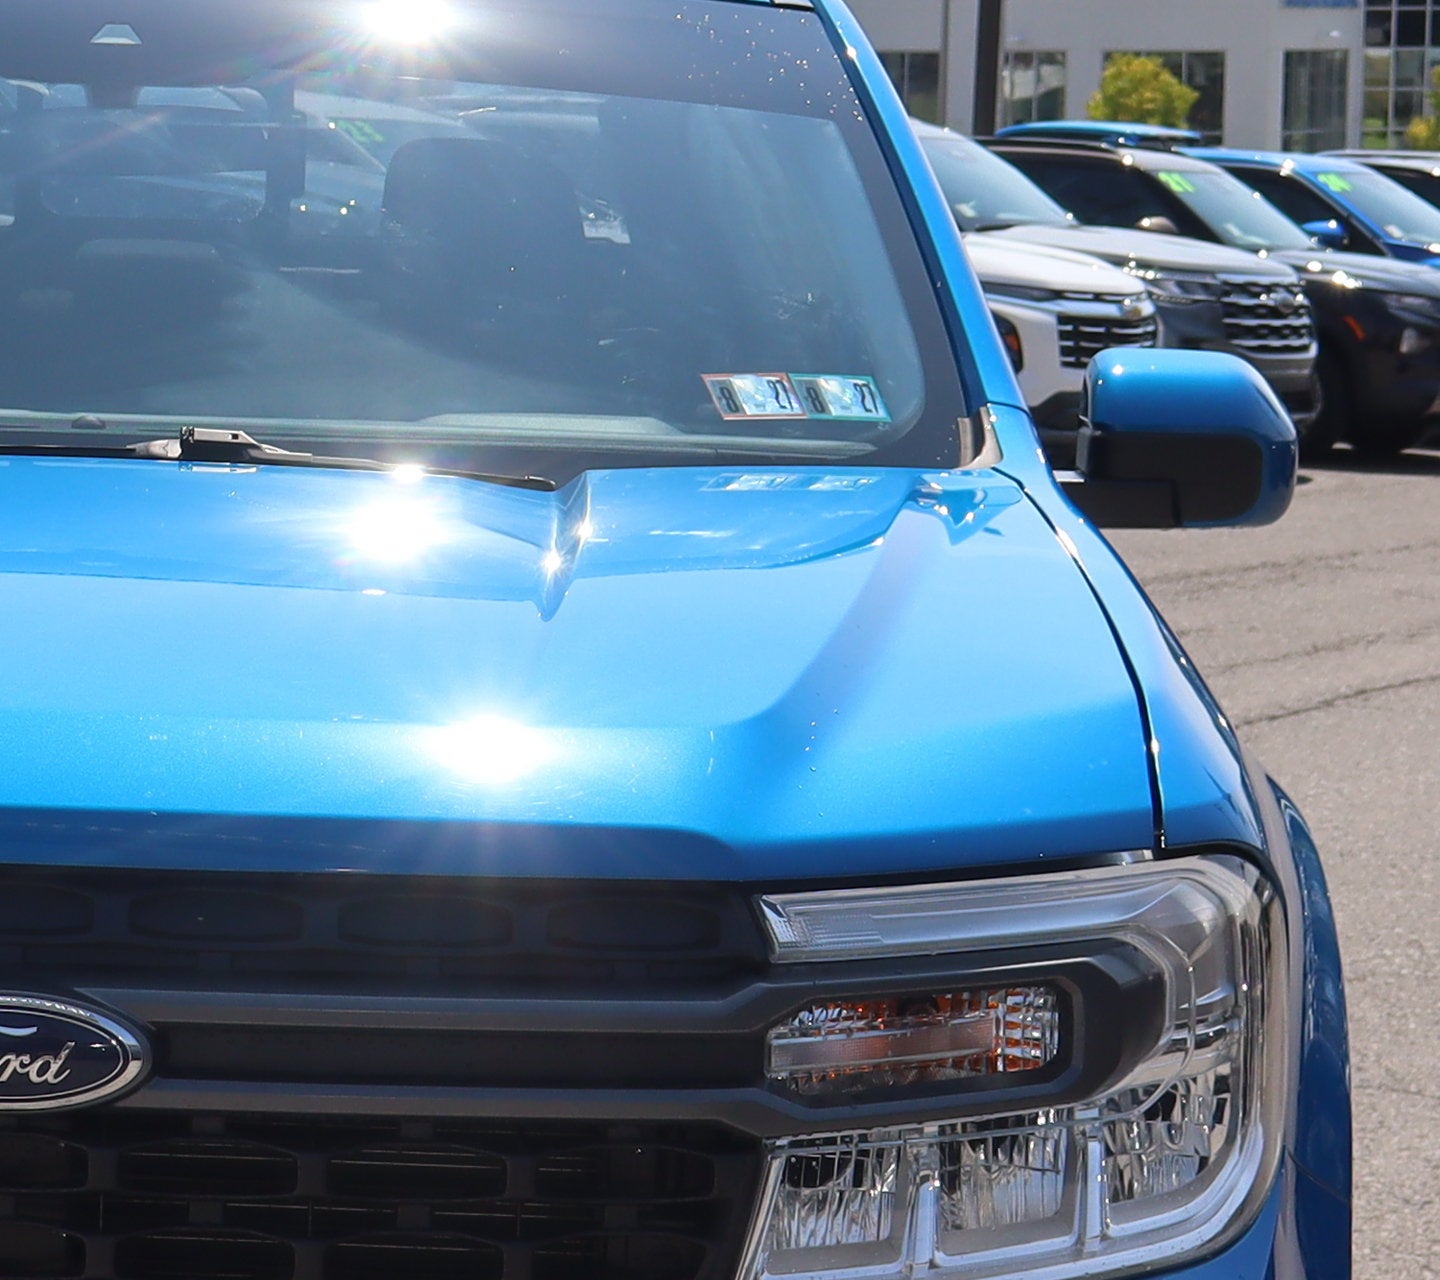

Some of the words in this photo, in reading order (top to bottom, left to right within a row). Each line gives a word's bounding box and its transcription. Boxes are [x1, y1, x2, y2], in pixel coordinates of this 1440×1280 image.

[720, 386, 740, 414] 8
[767, 379, 794, 412] 27
[806, 386, 826, 414] 8
[853, 382, 879, 415] 27
